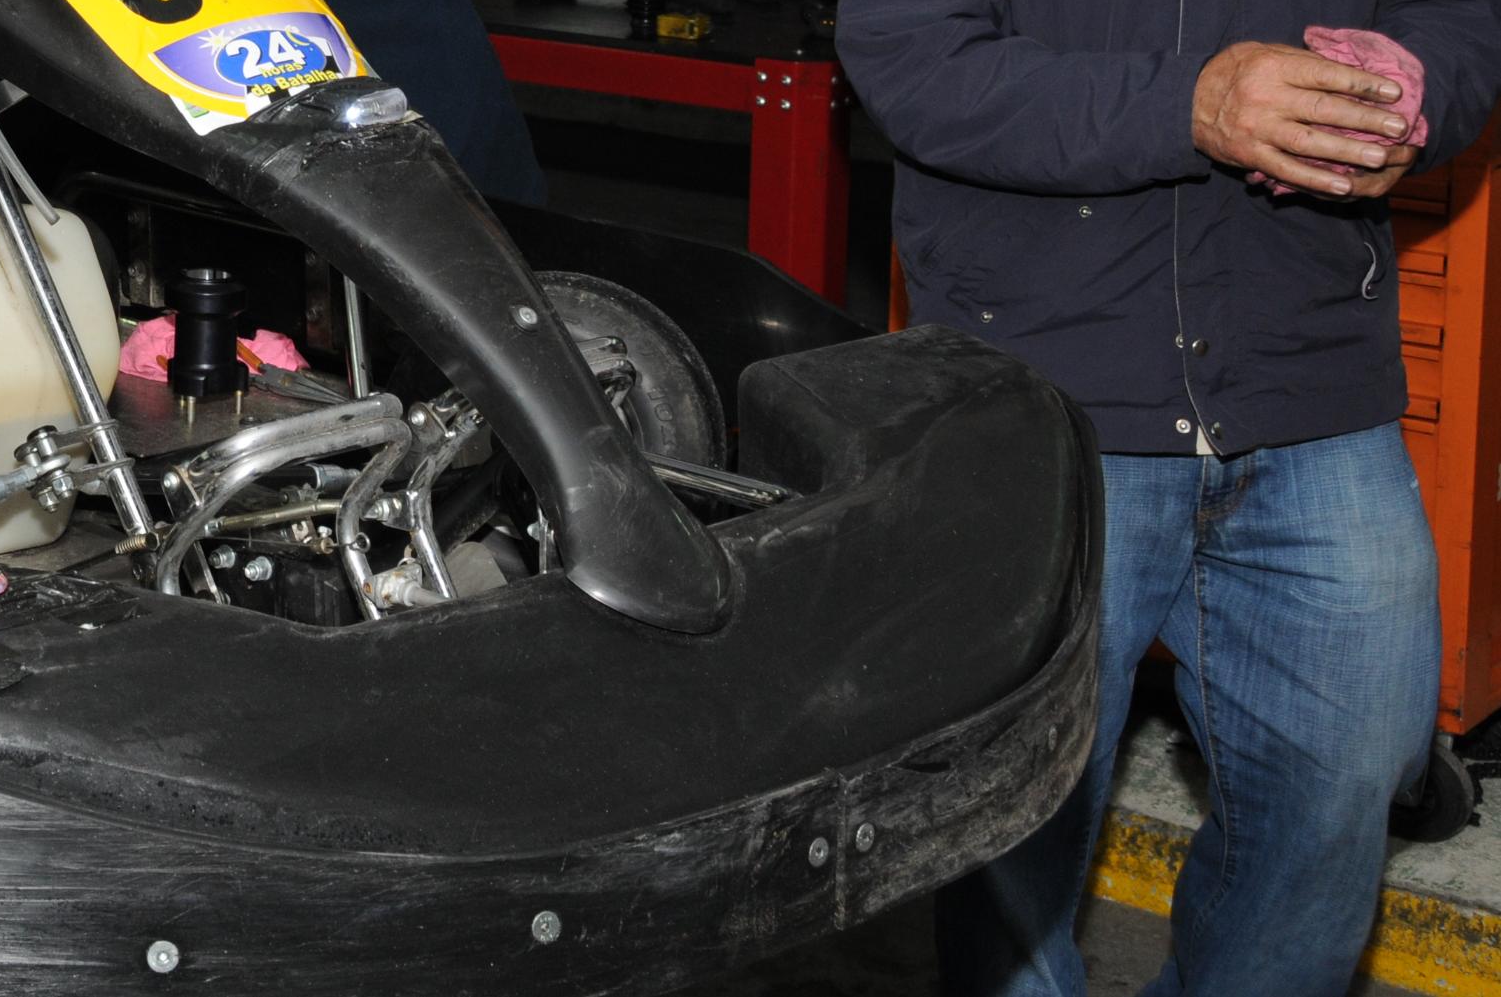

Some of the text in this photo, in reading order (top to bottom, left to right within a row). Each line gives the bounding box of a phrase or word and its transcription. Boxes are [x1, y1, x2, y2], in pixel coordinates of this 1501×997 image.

[225, 31, 306, 79] 24
[250, 68, 338, 97] da Batalha
[259, 62, 305, 78] horas
